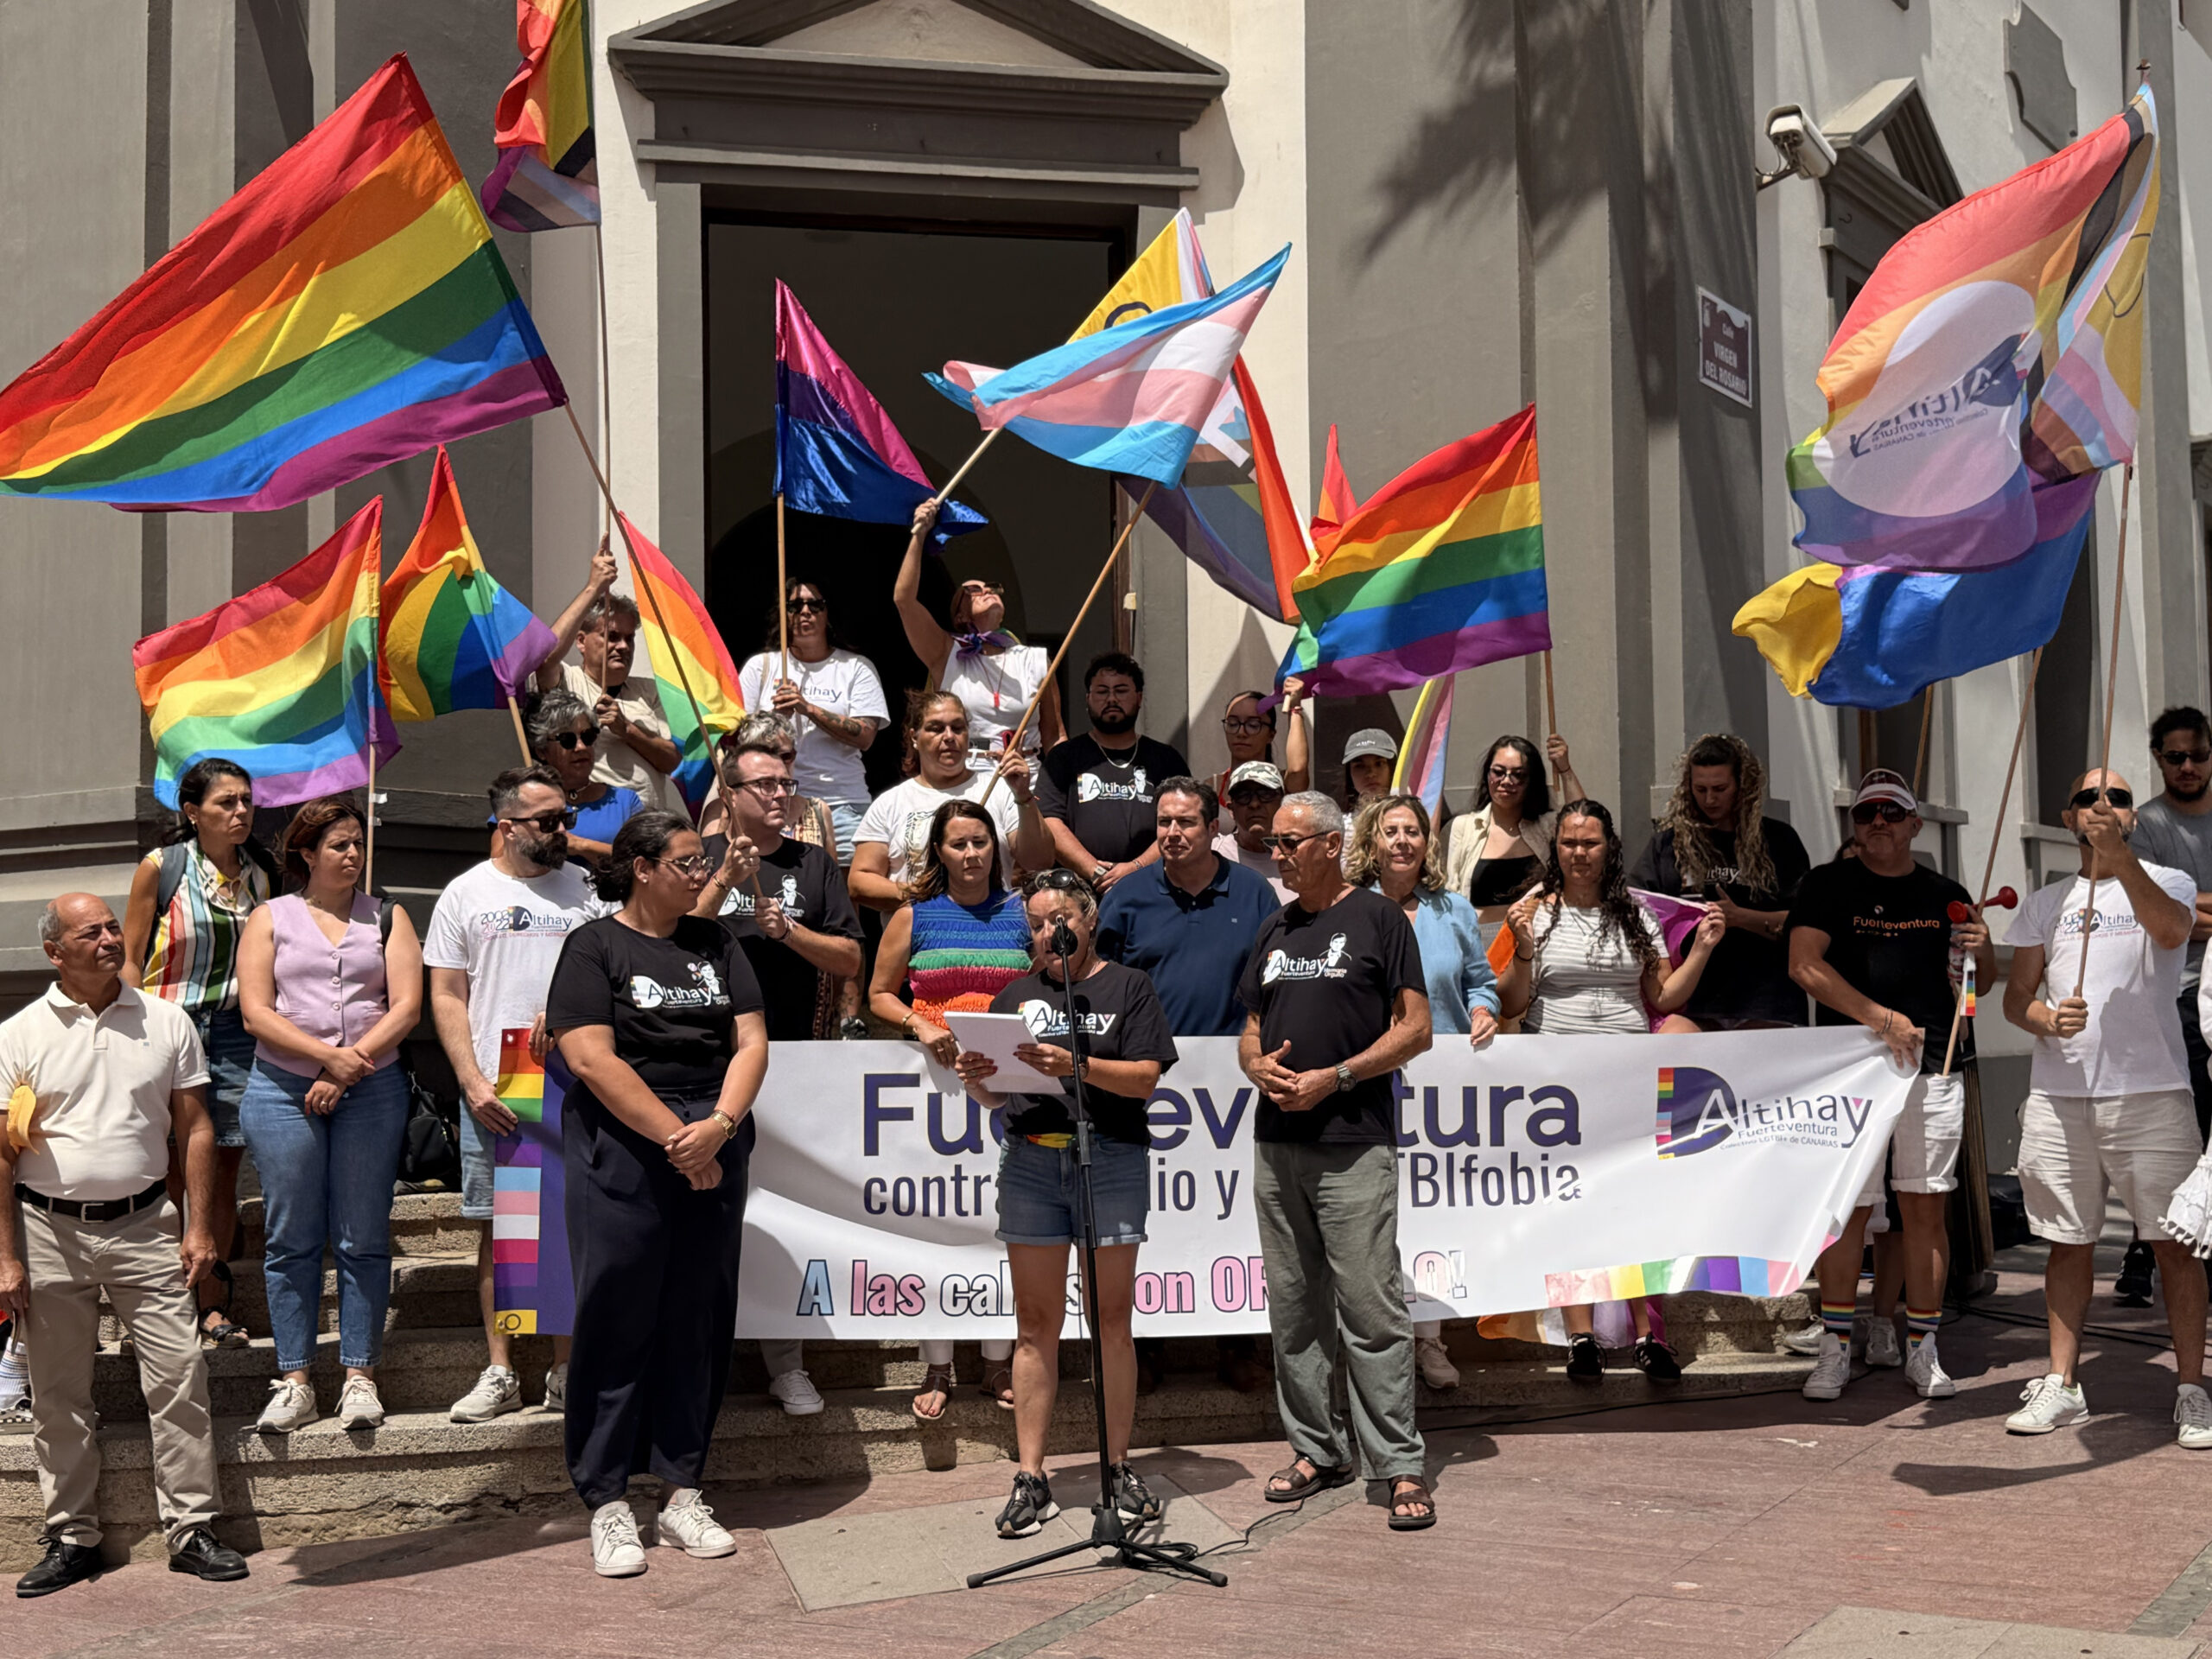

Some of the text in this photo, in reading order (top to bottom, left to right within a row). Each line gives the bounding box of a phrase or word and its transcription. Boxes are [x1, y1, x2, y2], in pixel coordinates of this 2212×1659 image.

[1713, 341, 1738, 369] VIRGEN
[1705, 359, 1747, 397] DEL ROSARIO
[1089, 779, 1136, 801] Altihay
[518, 912, 573, 931] Altihay
[1853, 915, 1940, 930] Fuerteventura
[1270, 955, 1329, 978] Altihay
[648, 982, 711, 1006] Altihay
[1694, 1087, 1873, 1149] Altihay
[1738, 1122, 1838, 1139] Fuerteventura
[1801, 1136, 1839, 1149] CANARIAS
[864, 1164, 1000, 1217] contr
[1215, 1169, 1238, 1220] y
[797, 1259, 835, 1317] A
[851, 1259, 927, 1317] las
